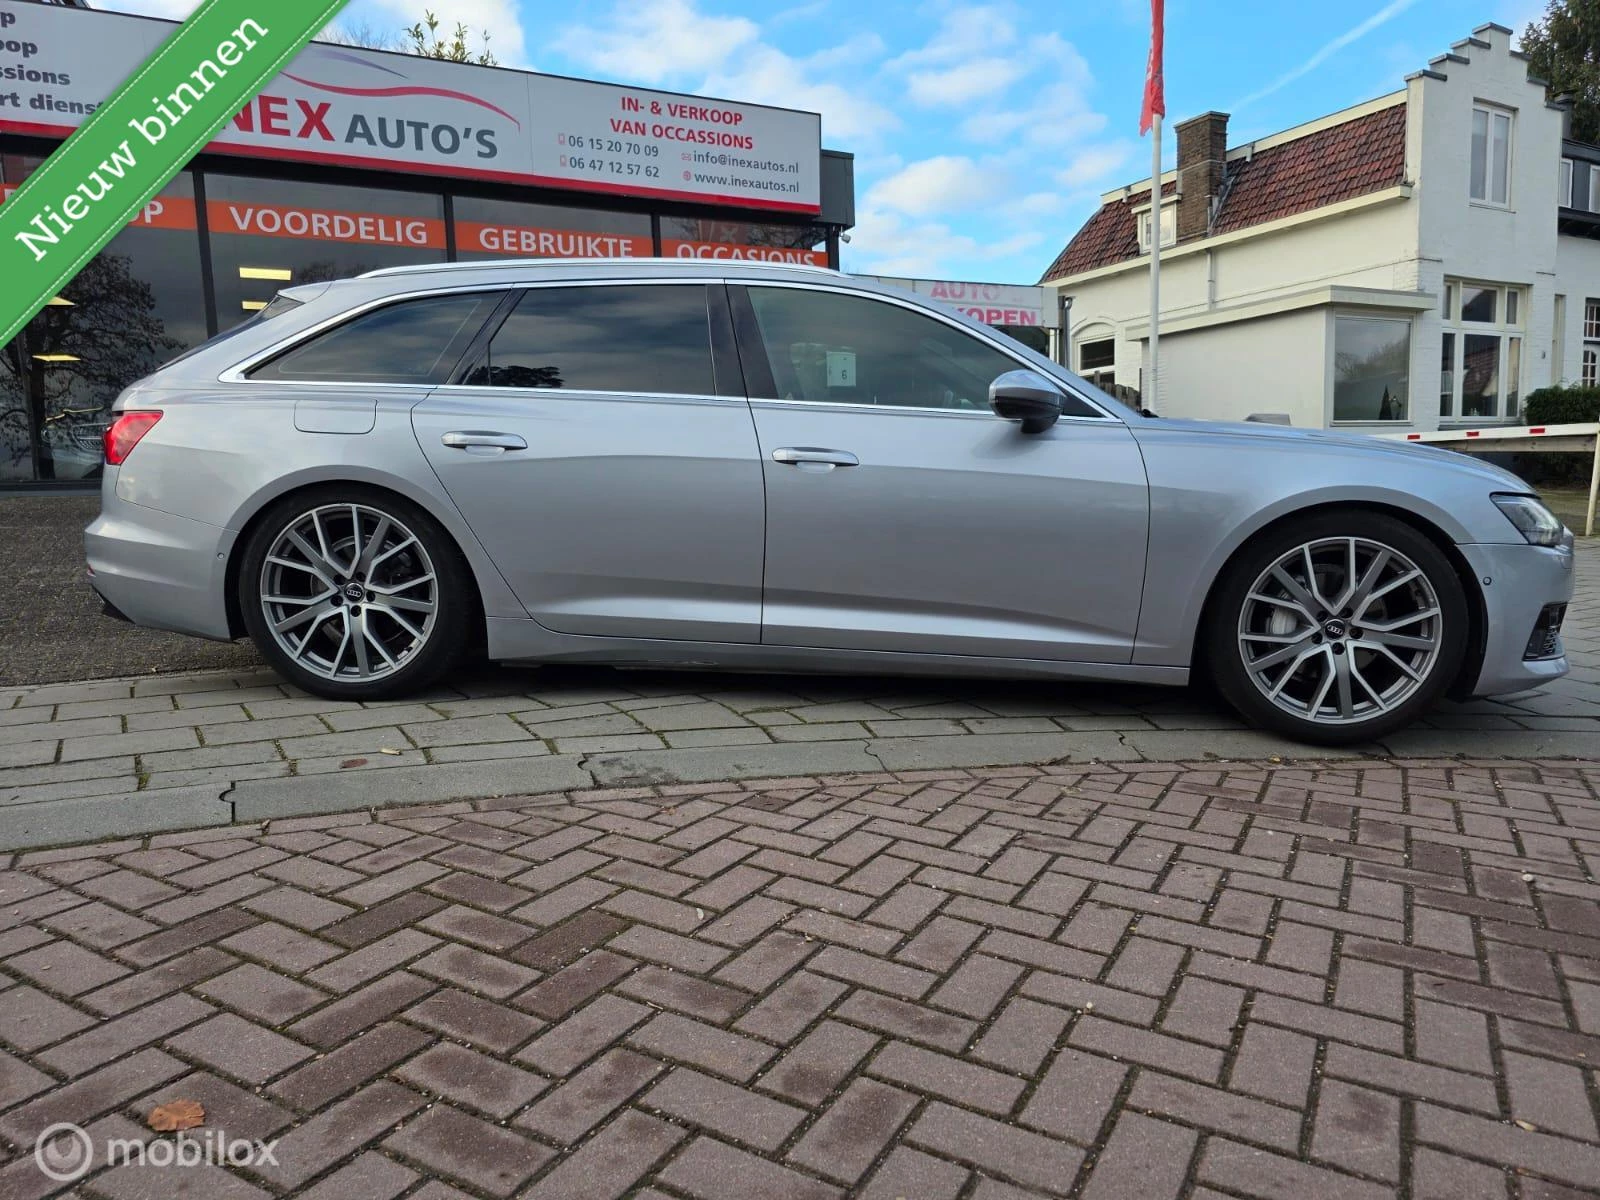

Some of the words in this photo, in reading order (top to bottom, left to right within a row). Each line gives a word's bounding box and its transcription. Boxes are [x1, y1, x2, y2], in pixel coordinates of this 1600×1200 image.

[621, 96, 644, 112] IN-
[650, 101, 662, 115] &
[667, 103, 743, 126] VERKOOP
[610, 118, 647, 136] VAN
[652, 124, 753, 149] OCCASSIONS
[568, 135, 584, 148] 06
[589, 138, 603, 150] 15
[607, 140, 622, 153] 20
[626, 142, 641, 155] 70
[644, 145, 659, 157] 09
[569, 157, 585, 169] 06
[589, 159, 603, 171] 47
[608, 161, 623, 174] 12
[627, 163, 641, 176] 57
[645, 165, 660, 178] 62
[693, 150, 799, 173] info@inexautos.nl
[694, 173, 800, 193] www.inexautos.nl
[229, 206, 428, 244] VOORDELIG
[479, 226, 633, 259] GEBRUIKTE
[677, 244, 815, 266] OCCASIONS
[930, 281, 1001, 301] AUTO
[957, 307, 1037, 326] OPEN
